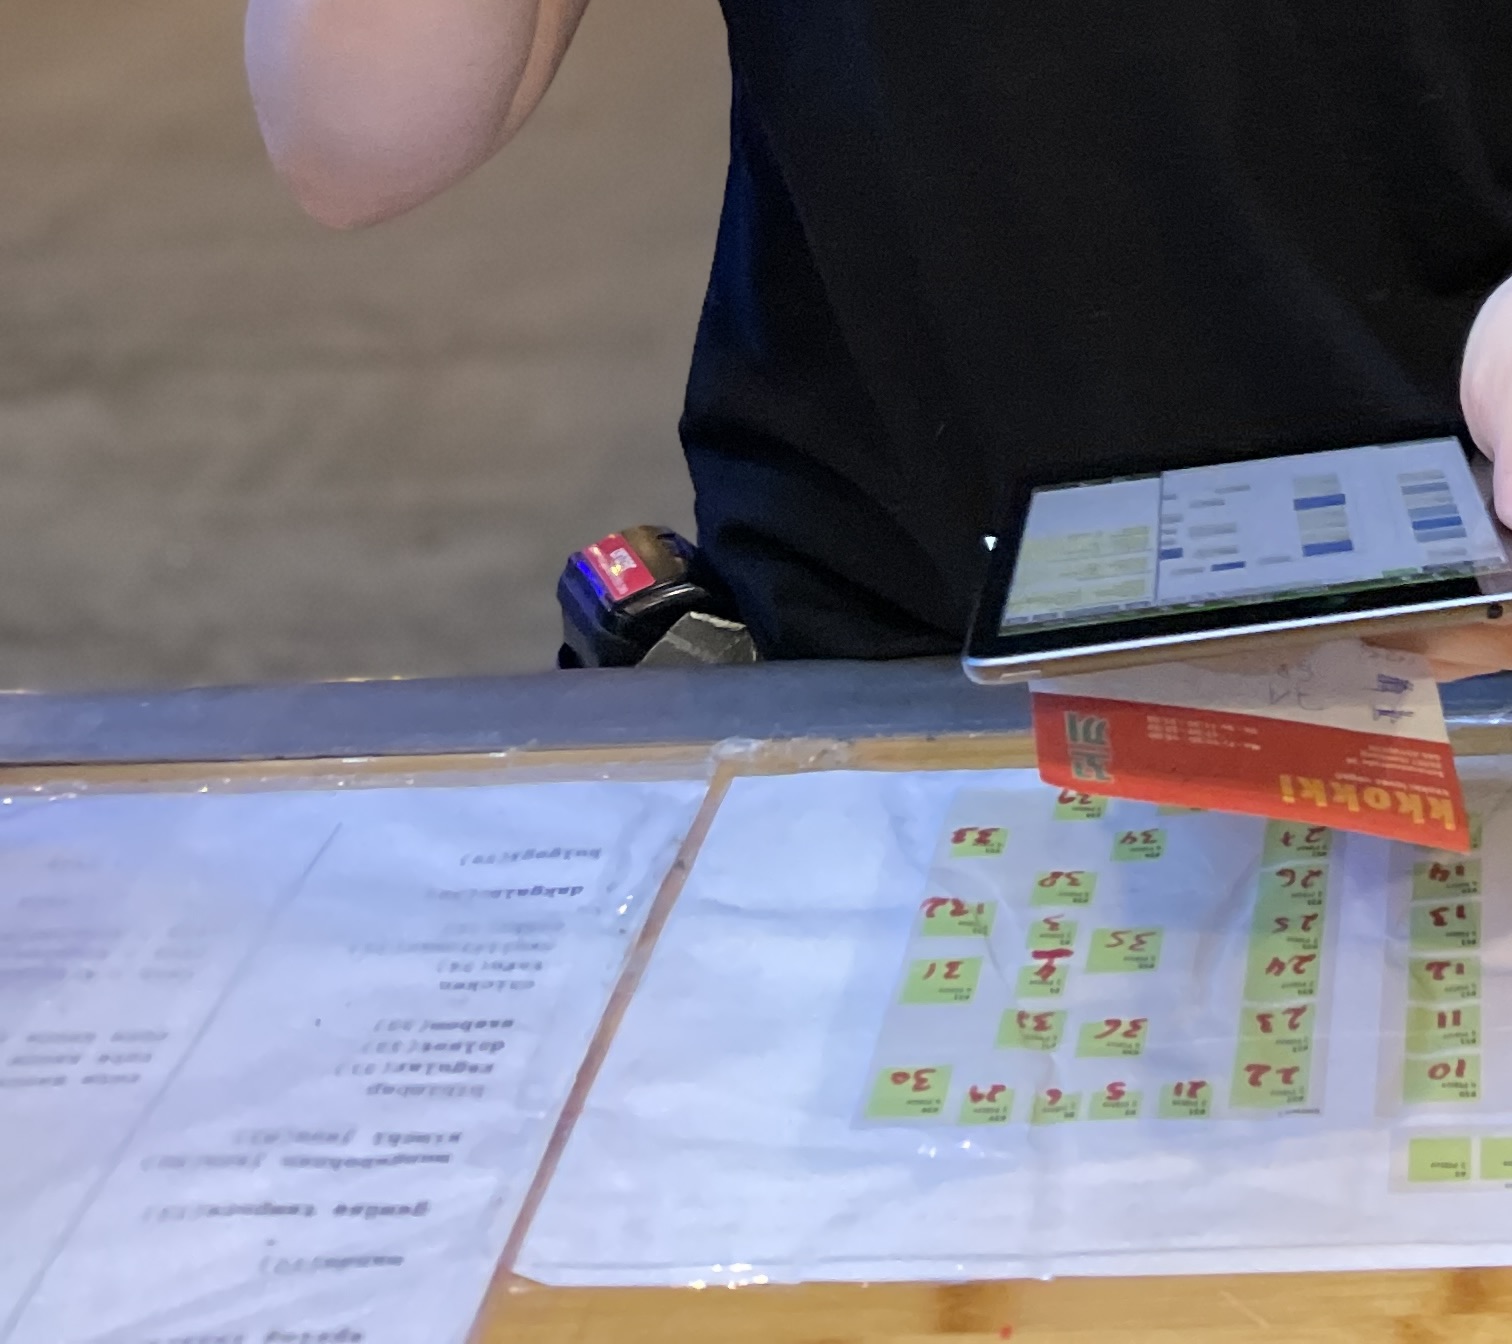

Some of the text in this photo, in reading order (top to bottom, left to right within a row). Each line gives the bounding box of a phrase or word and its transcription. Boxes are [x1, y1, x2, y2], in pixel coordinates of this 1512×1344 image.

[1279, 774, 1457, 831] kkokki
[1120, 829, 1161, 845] 34
[1275, 868, 1322, 890] 26
[1272, 913, 1319, 933] 25
[1431, 903, 1466, 927] 13
[1105, 930, 1156, 951] 35
[923, 961, 965, 980] 31
[1266, 954, 1315, 976] 24
[1426, 960, 1466, 980] 12
[1094, 1017, 1148, 1039] 36
[1257, 1007, 1306, 1033] 23
[1437, 1010, 1462, 1028] 11
[1245, 1063, 1299, 1087] 22
[1428, 1058, 1466, 1079] 10
[890, 1068, 936, 1091] 30
[1106, 1079, 1126, 1101] 5
[1174, 1080, 1208, 1098] 21
[1045, 1087, 1063, 1104] 6
